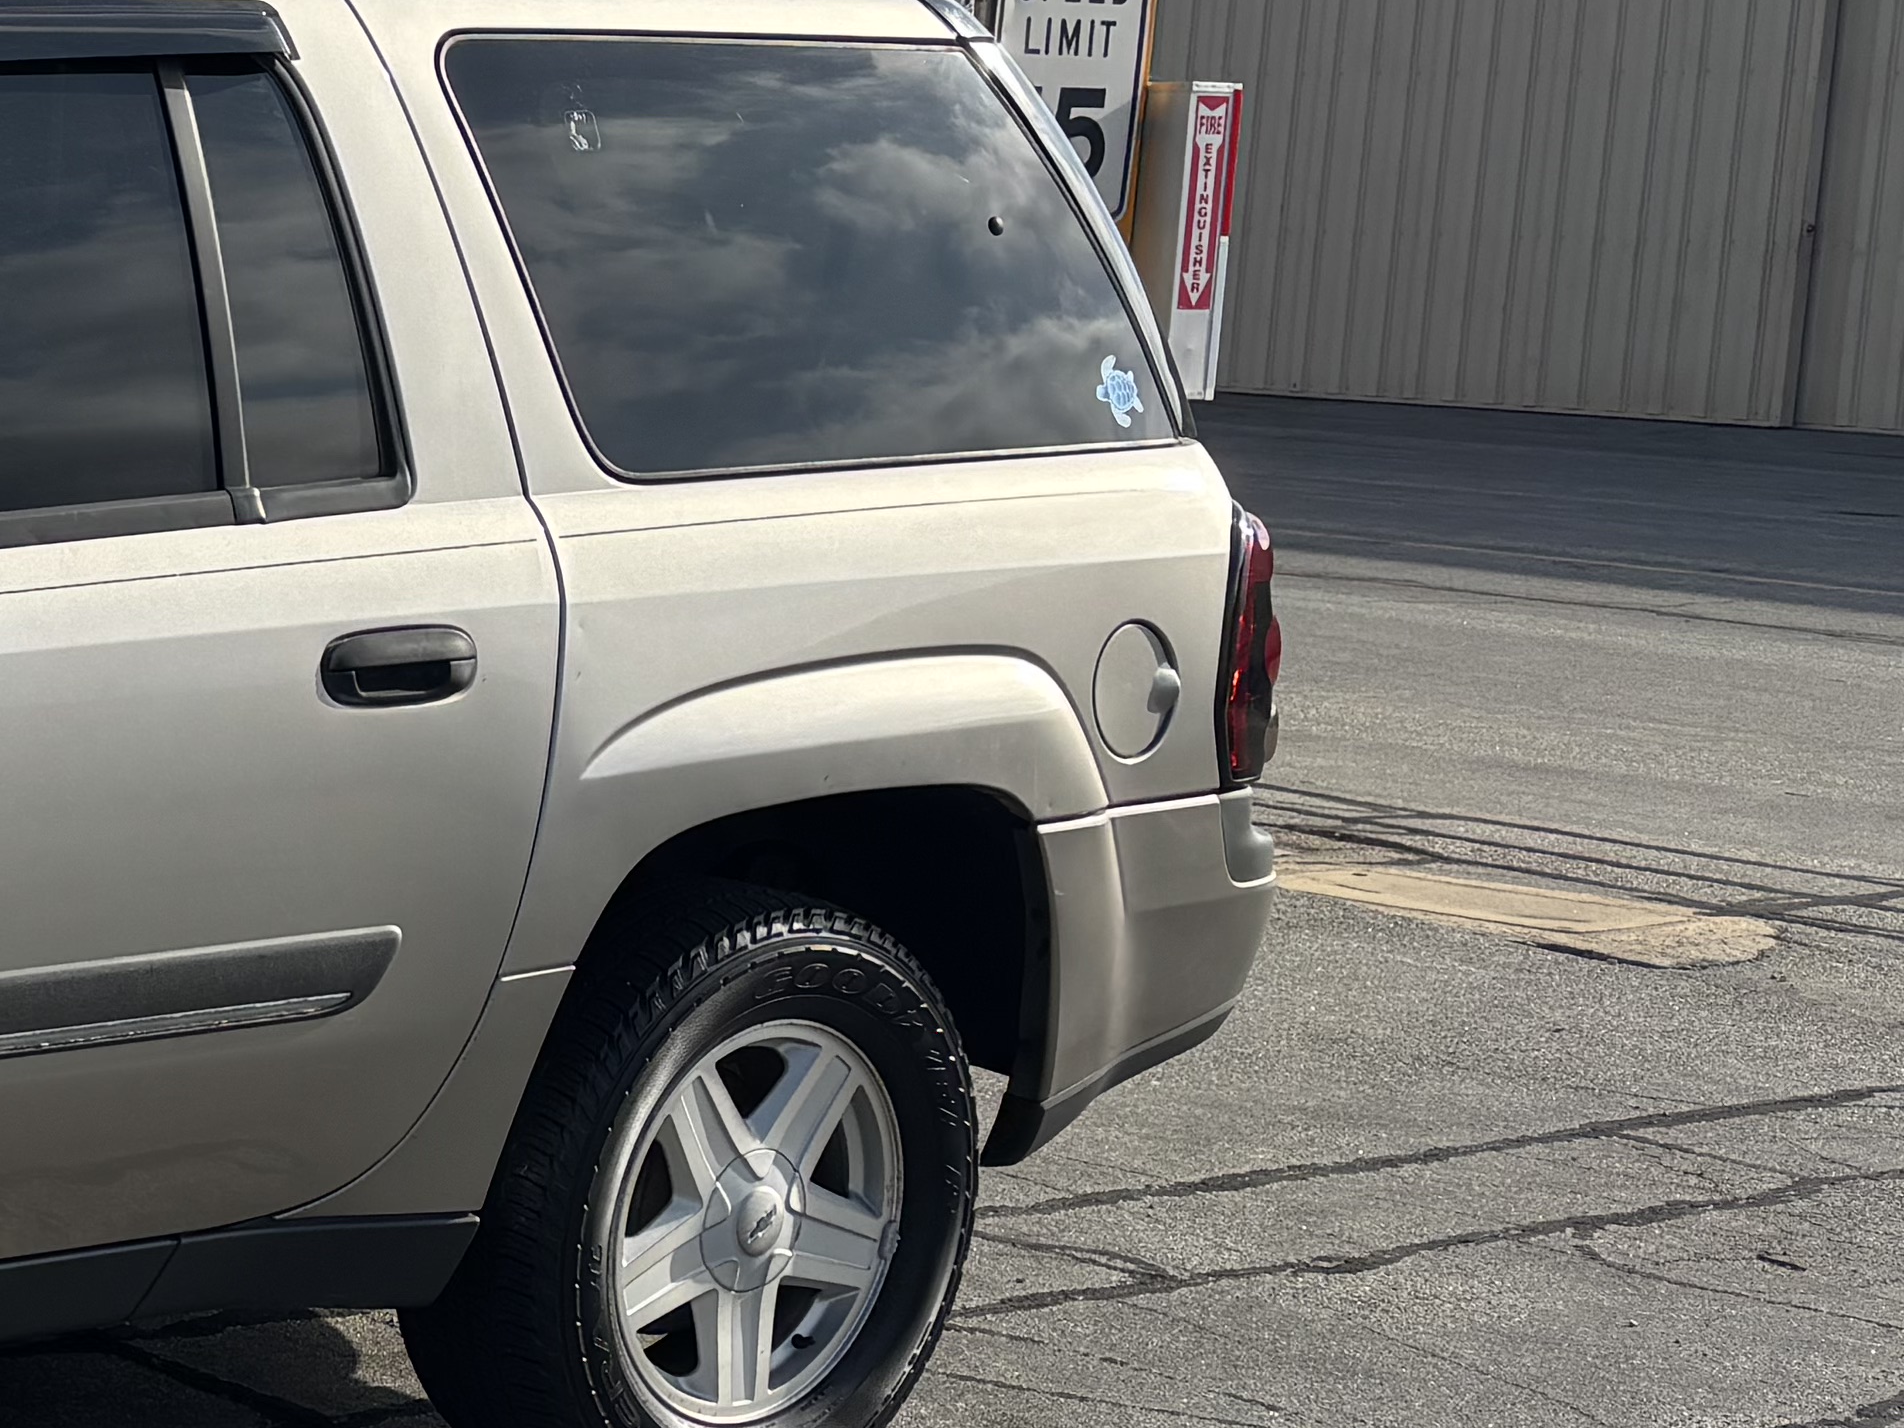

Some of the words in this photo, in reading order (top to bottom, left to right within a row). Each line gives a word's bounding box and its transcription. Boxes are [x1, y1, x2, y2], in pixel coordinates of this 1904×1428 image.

[1024, 16, 1117, 58] LIMIT
[1033, 86, 1107, 178] 5
[1198, 115, 1224, 135] FIRE
[1190, 143, 1214, 294] EXTINGUISHER
